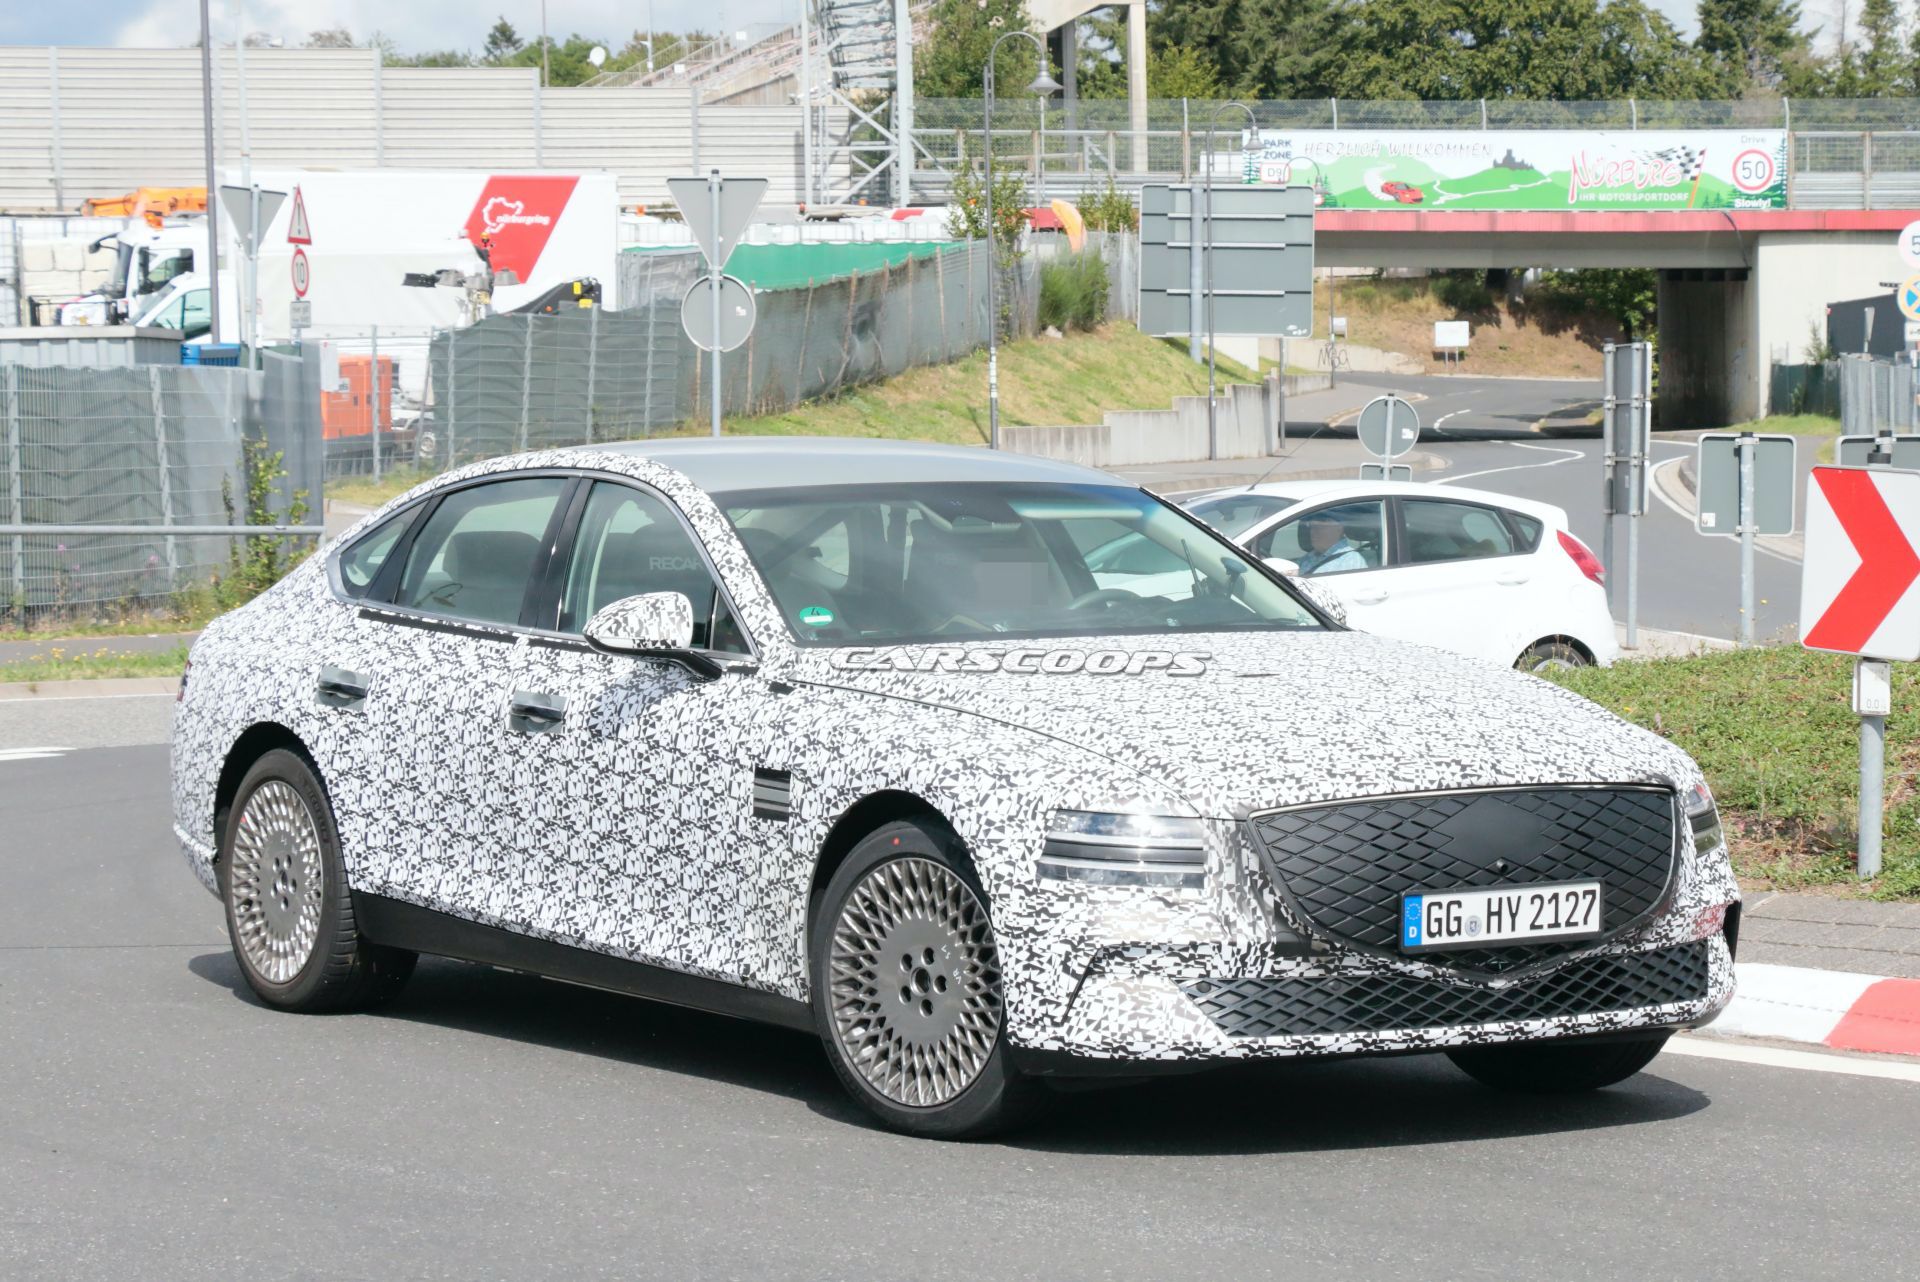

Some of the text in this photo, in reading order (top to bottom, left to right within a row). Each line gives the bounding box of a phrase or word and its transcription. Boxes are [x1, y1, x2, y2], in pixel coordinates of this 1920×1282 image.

[1263, 139, 1292, 148] PARK
[1741, 135, 1766, 144] Drive
[1263, 151, 1292, 160] ZONE
[1304, 142, 1493, 157] HERZLICH WILLKOMMEN
[1267, 167, 1283, 177] D9
[1742, 160, 1766, 180] 50
[1579, 192, 1689, 202] IHR MOTORSPORTDORF
[295, 261, 305, 284] 10
[649, 556, 704, 570] RECAR
[1426, 888, 1597, 939] GG HY 2127
[1408, 925, 1418, 938] D
